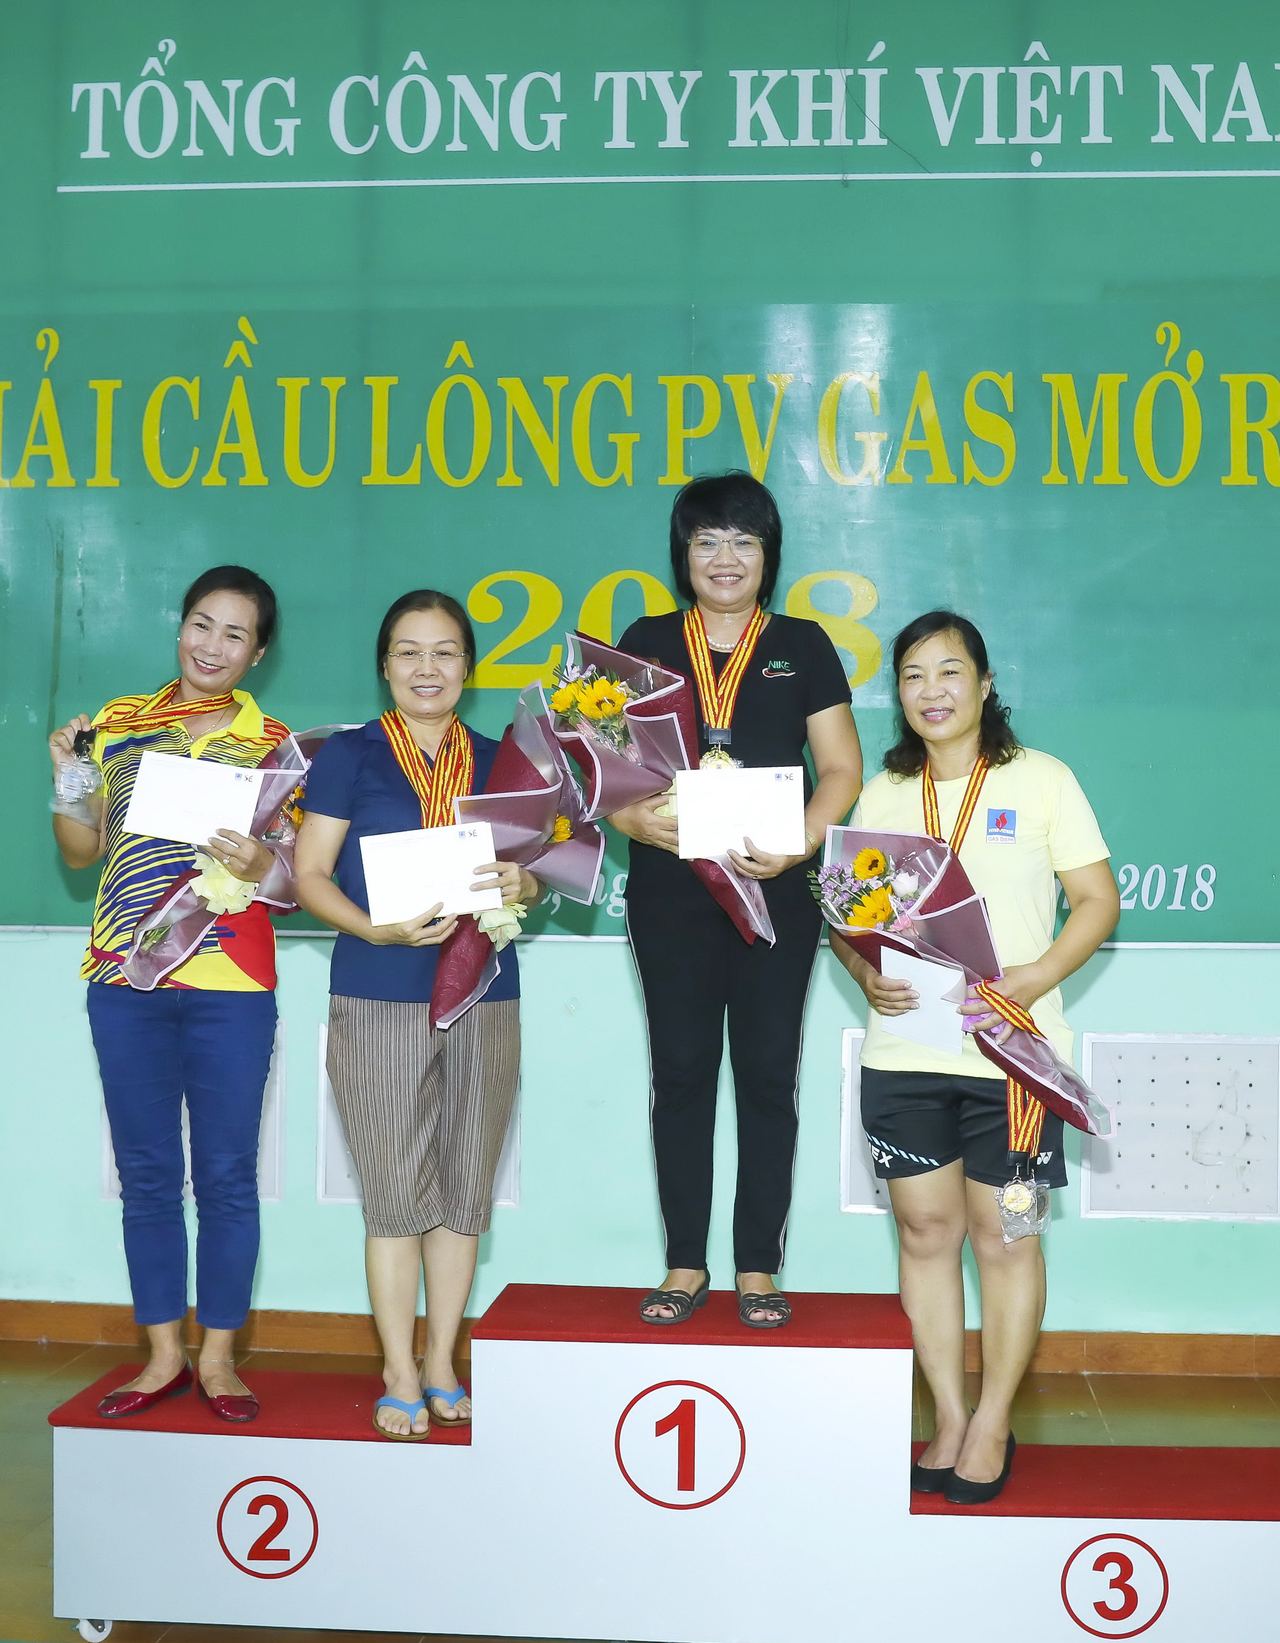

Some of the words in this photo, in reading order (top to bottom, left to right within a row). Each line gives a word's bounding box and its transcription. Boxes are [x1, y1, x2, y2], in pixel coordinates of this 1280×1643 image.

[71, 39, 301, 159] TỔNG
[329, 51, 567, 154] CÔNG
[594, 71, 702, 149] TY
[728, 41, 888, 147] KHÍ
[915, 41, 1123, 167] VIỆT
[1151, 62, 1280, 144] NA
[142, 316, 346, 488] CẦU
[362, 340, 640, 487] LÔNG
[658, 374, 793, 485] PV
[817, 370, 1017, 486] GAS
[1042, 321, 1204, 487] MỞ
[465, 569, 883, 690] 208
[768, 660, 791, 671] NIKE
[1118, 863, 1216, 911] 2018
[655, 1399, 696, 1491] 1
[247, 1494, 290, 1561] 2
[1092, 1552, 1138, 1621] 3
